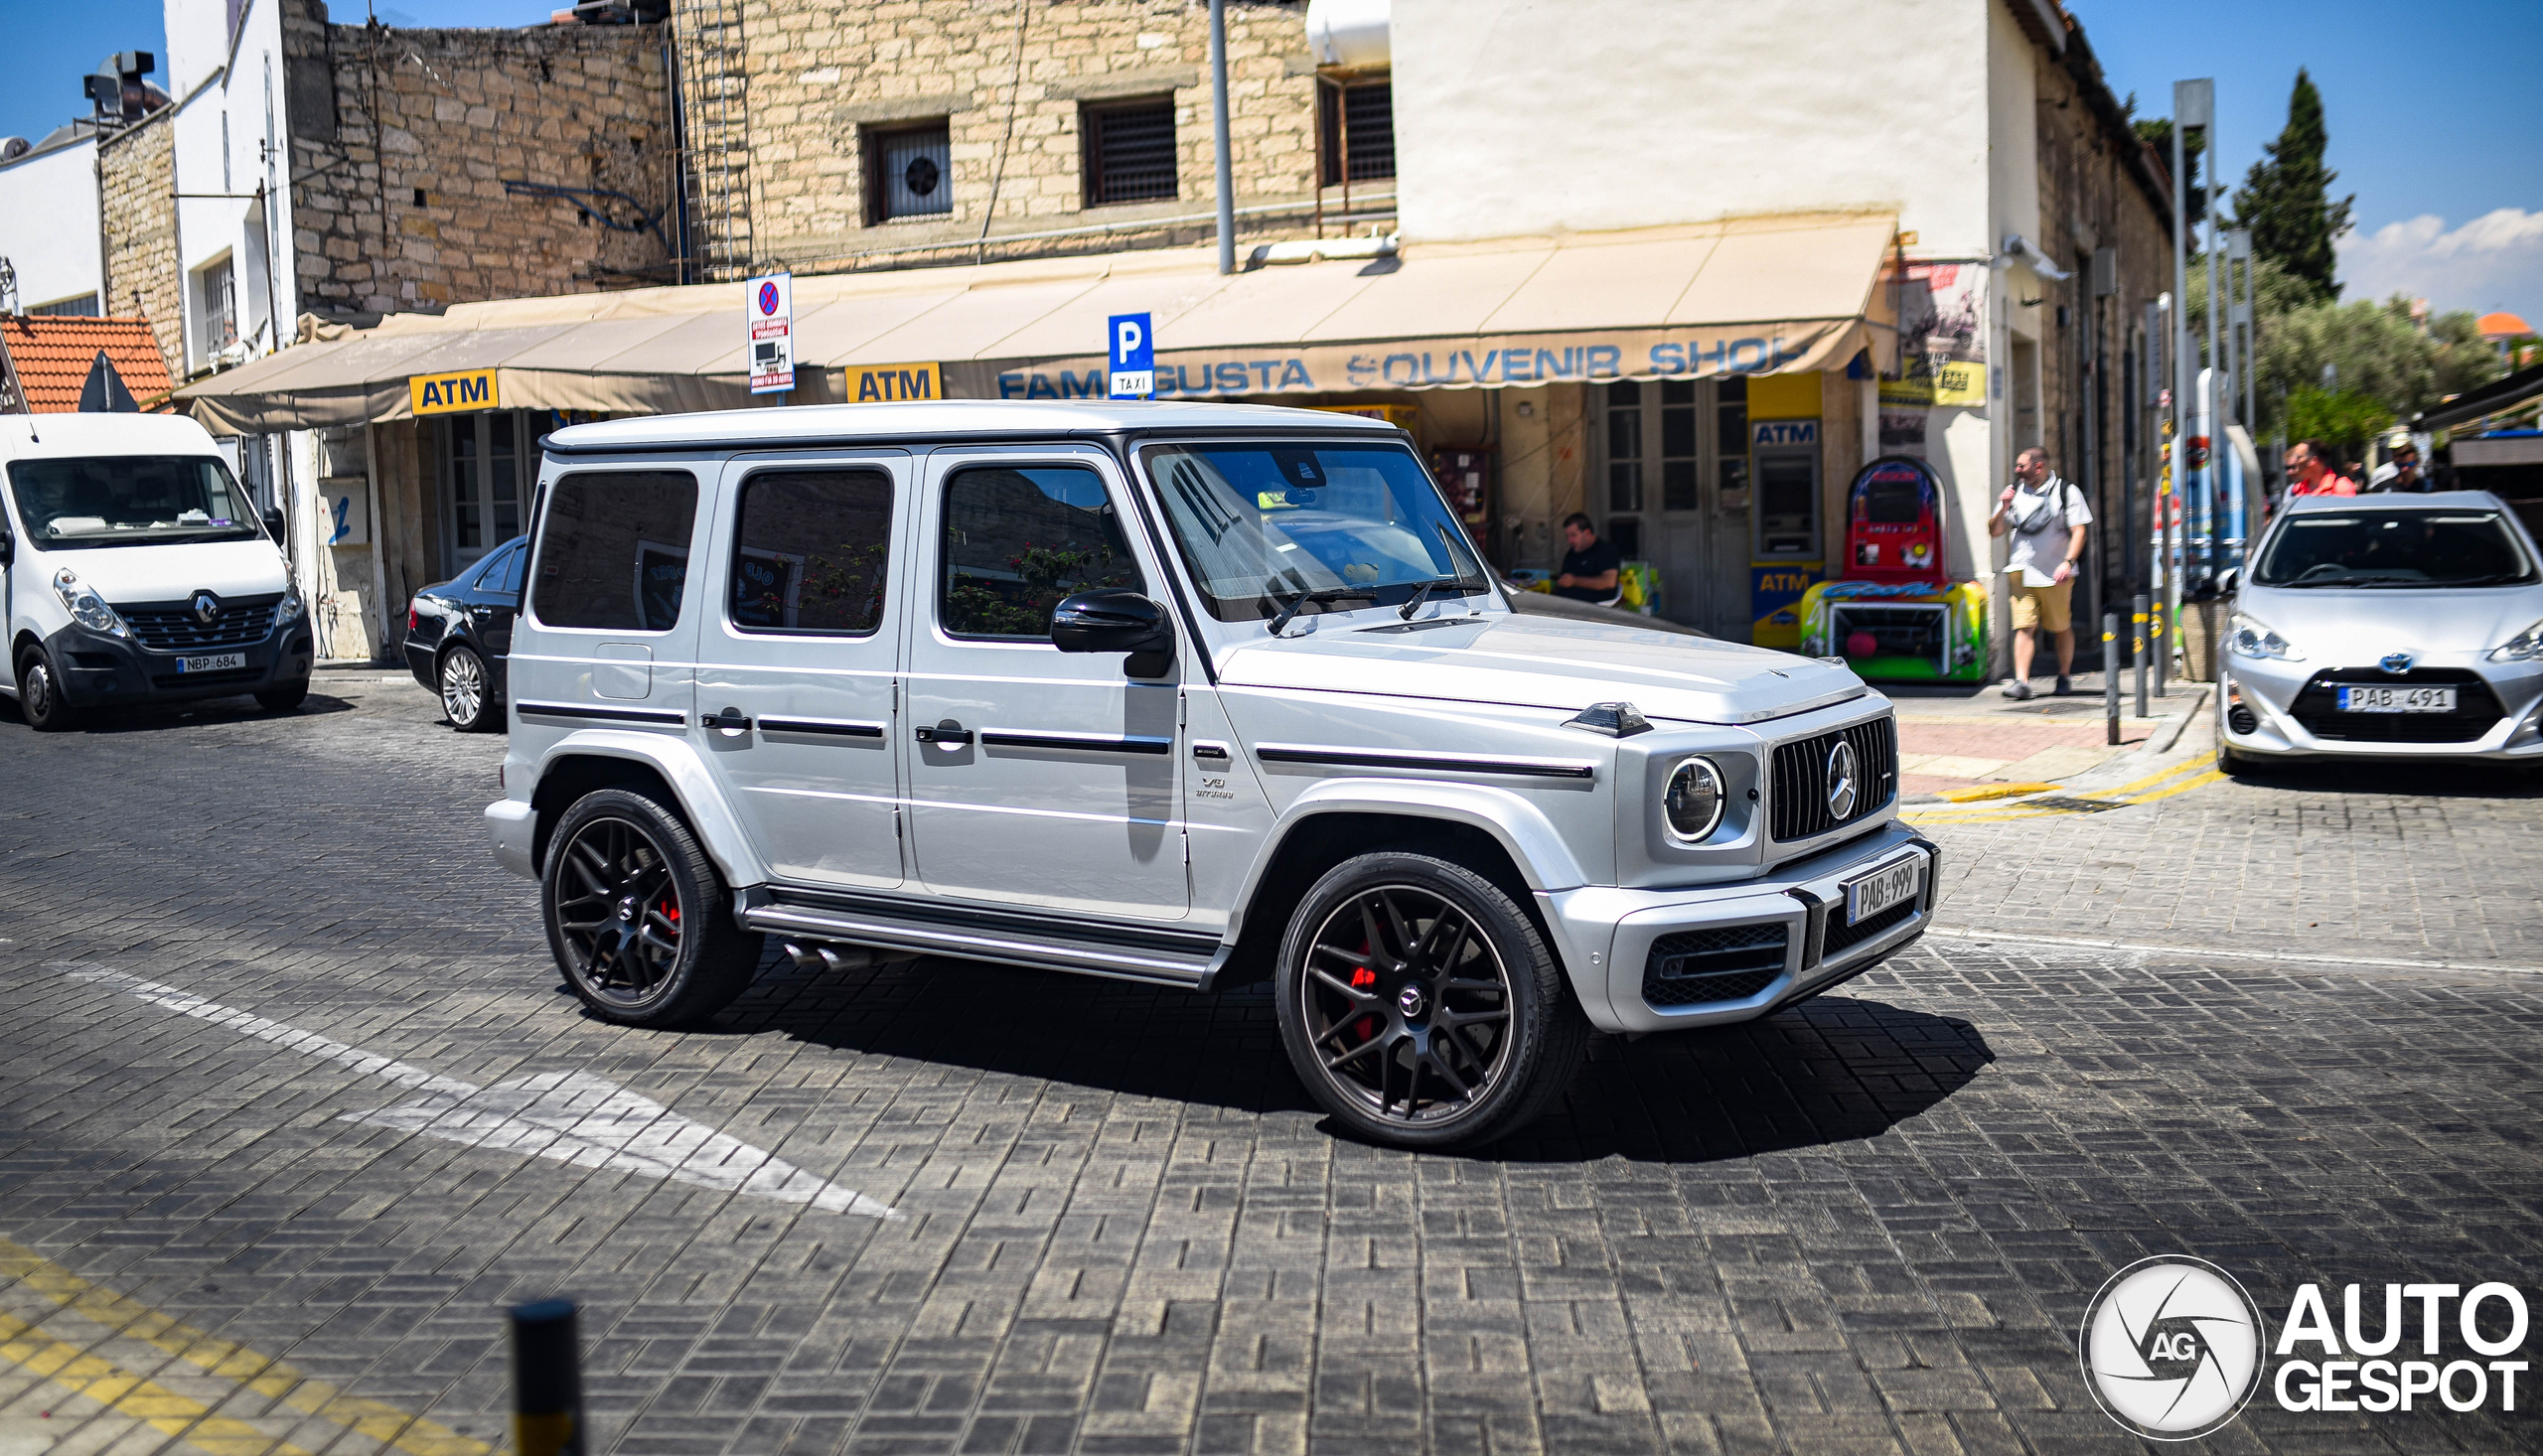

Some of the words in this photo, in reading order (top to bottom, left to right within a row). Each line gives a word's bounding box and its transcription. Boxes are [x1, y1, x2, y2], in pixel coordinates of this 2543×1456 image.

[1119, 321, 1142, 364] P
[997, 359, 1315, 399] FAMGUSTA
[1346, 344, 1622, 388] SOUVENIR
[1119, 377, 1145, 390] TAXI
[421, 376, 489, 407] ATM
[858, 369, 931, 401] ATM
[1756, 424, 1814, 443] ATM
[1759, 574, 1810, 592] ATM
[187, 657, 210, 670] NBP
[216, 655, 236, 667] 684
[2352, 688, 2392, 706] PAB
[2407, 688, 2447, 706] 491
[1861, 877, 1884, 916] PAB
[1892, 864, 1913, 901] 999
